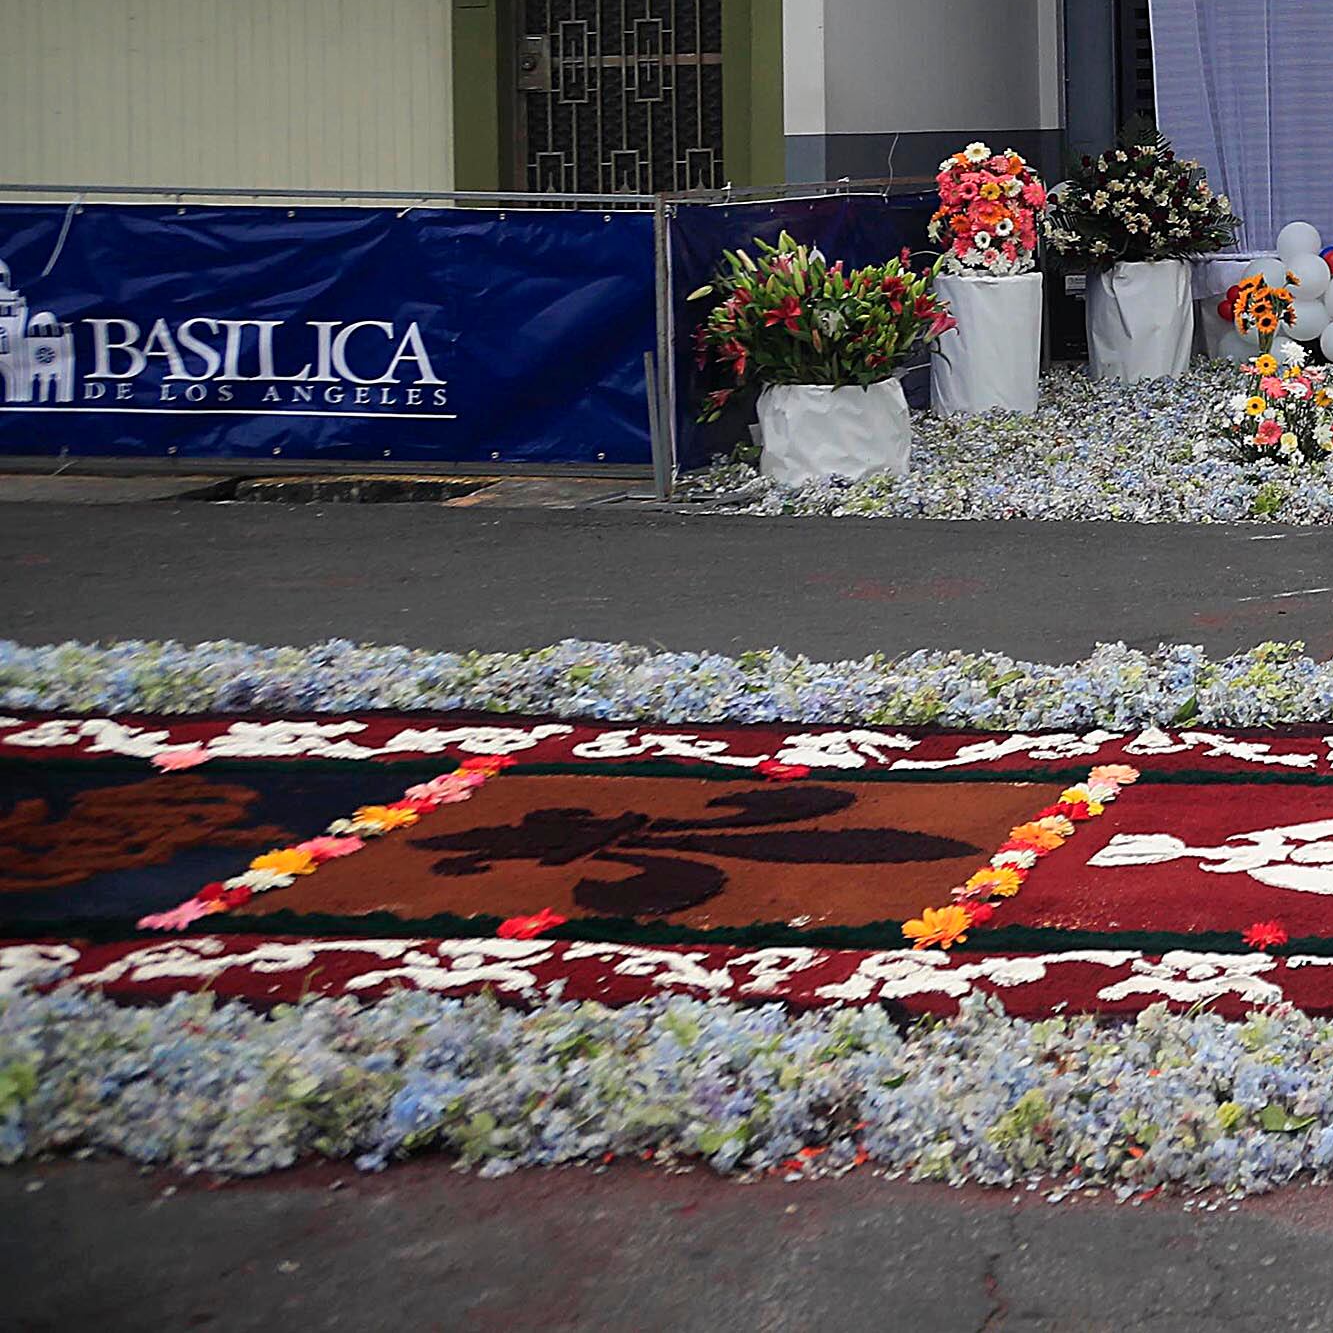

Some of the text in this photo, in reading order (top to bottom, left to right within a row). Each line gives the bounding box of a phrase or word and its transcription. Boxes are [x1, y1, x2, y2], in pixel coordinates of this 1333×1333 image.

[81, 318, 448, 385] BASILICA
[83, 382, 448, 407] DE LOS ANGELES
